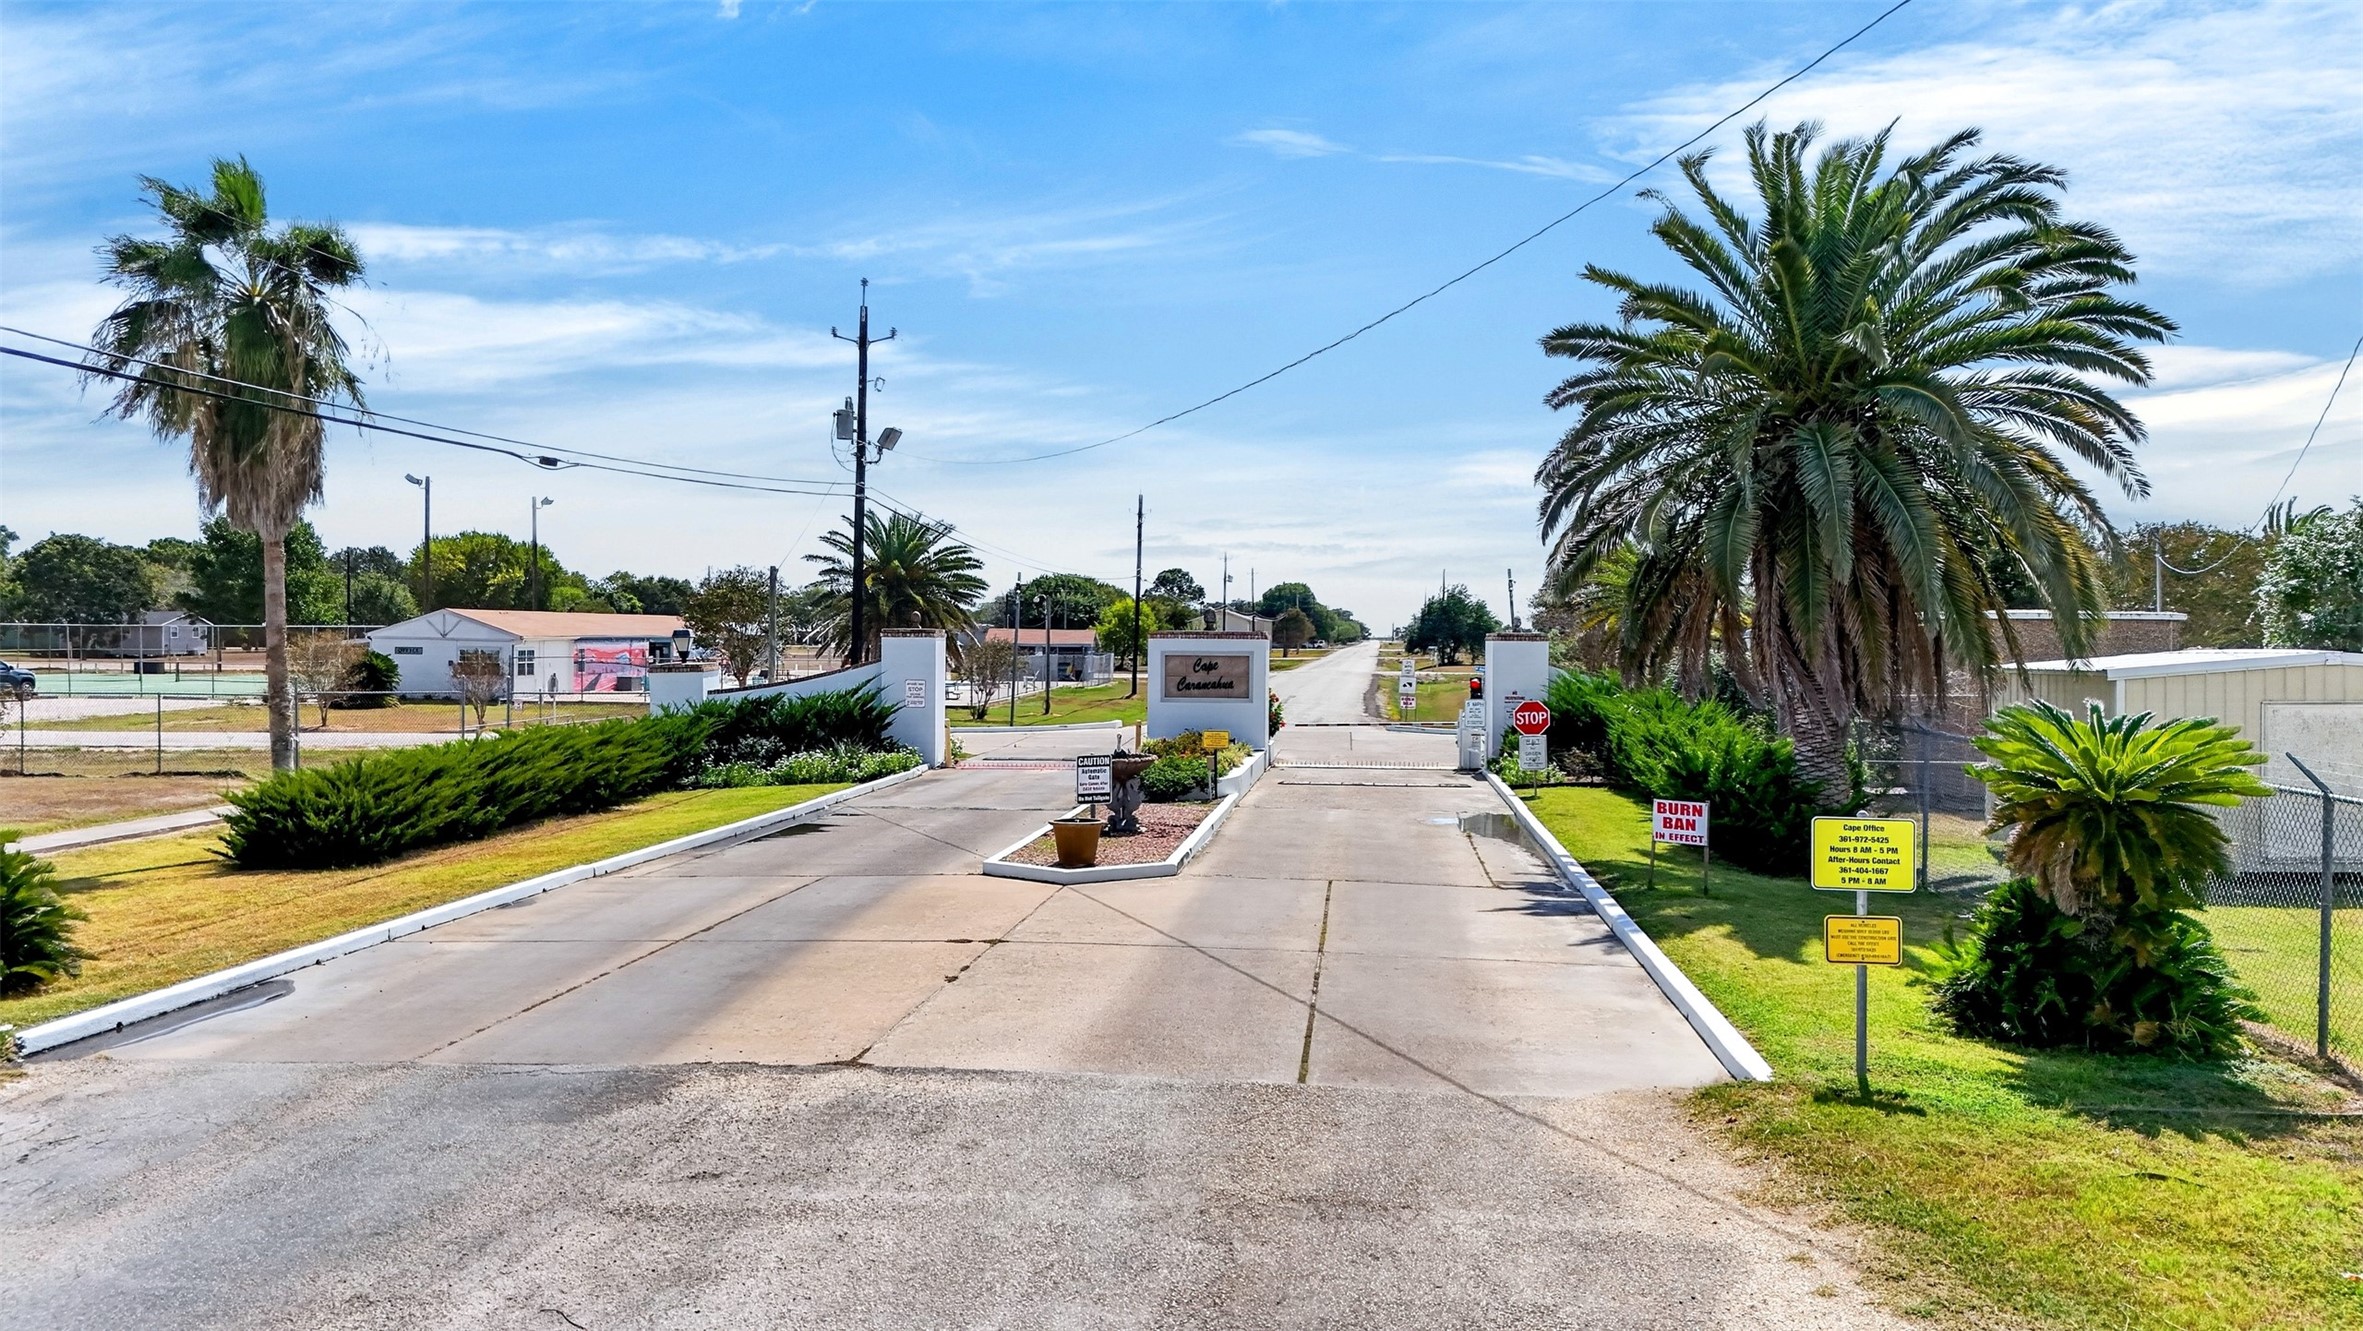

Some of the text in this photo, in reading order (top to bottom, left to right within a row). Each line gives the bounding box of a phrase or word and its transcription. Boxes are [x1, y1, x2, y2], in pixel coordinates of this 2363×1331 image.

[1193, 657, 1219, 675] Cape
[1516, 712, 1547, 724] STOP
[1078, 756, 1110, 766] CAUTION
[1657, 802, 1703, 817] BURN
[1663, 817, 1696, 831] BAN
[1844, 824, 1861, 832] Cape
[1669, 833, 1704, 843] EFFECT
